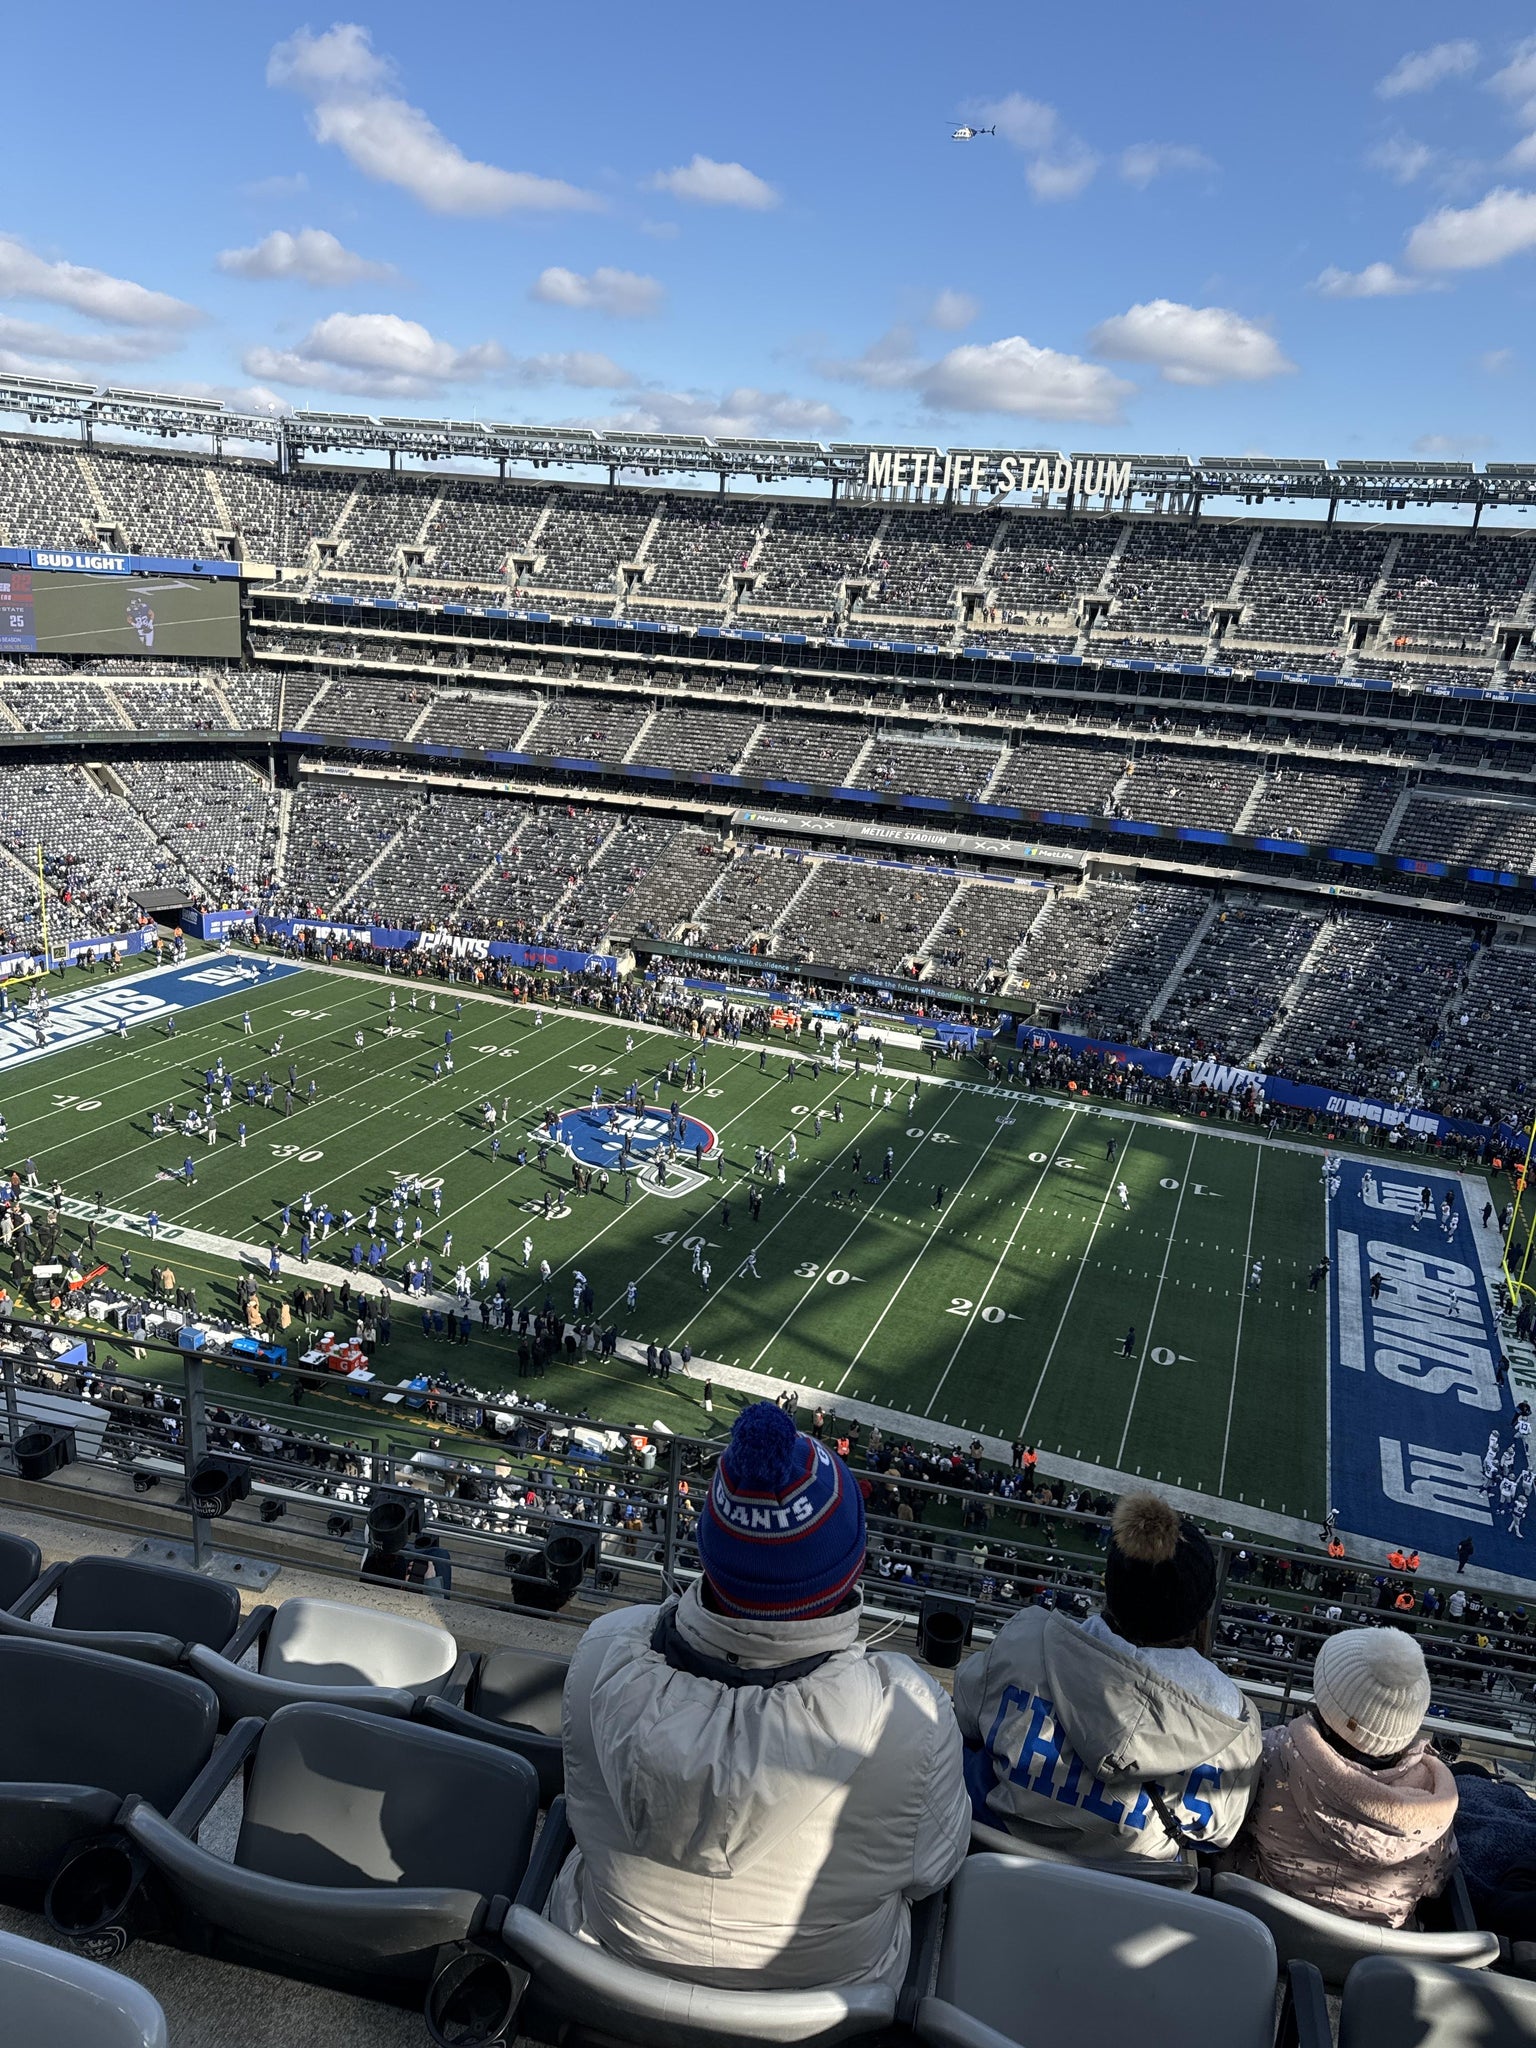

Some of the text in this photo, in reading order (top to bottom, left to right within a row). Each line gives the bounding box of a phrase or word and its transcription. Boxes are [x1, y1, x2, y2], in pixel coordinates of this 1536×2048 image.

[867, 452, 1132, 496] METLIFE STADIUM
[37, 554, 124, 571] BUD LIGHT
[10, 615, 24, 627] 25
[756, 814, 789, 824] MetLife
[861, 827, 947, 845] METLIFE STADIUM
[1038, 849, 1074, 859] MetLife
[1339, 888, 1362, 897] MetLife
[54, 948, 67, 958] 25
[684, 949, 790, 971] Shape the future with confidence
[862, 977, 975, 1003] Shape the future with confidence
[289, 1008, 332, 1021] 10
[478, 1044, 519, 1058] 30
[577, 1063, 619, 1076] 40
[51, 1095, 102, 1112] 10
[943, 1080, 1103, 1113] AMERICA 250
[1326, 1095, 1440, 1135] GO BIG BLUE
[906, 1127, 952, 1144] 30
[272, 1144, 324, 1163] 30
[1028, 1151, 1078, 1169] 20
[1159, 1177, 1209, 1196] 10
[653, 1231, 706, 1250] 40
[793, 1262, 851, 1286] 30
[946, 1297, 1007, 1324] 20
[1366, 1239, 1503, 1412] GIANTS
[340, 1361, 348, 1370] G
[1505, 1344, 1536, 1390] LOVE
[1521, 1423, 1529, 1431] 13
[982, 1584, 992, 1594] 56
[1469, 1602, 1480, 1611] 90
[1232, 1632, 1239, 1640] 7
